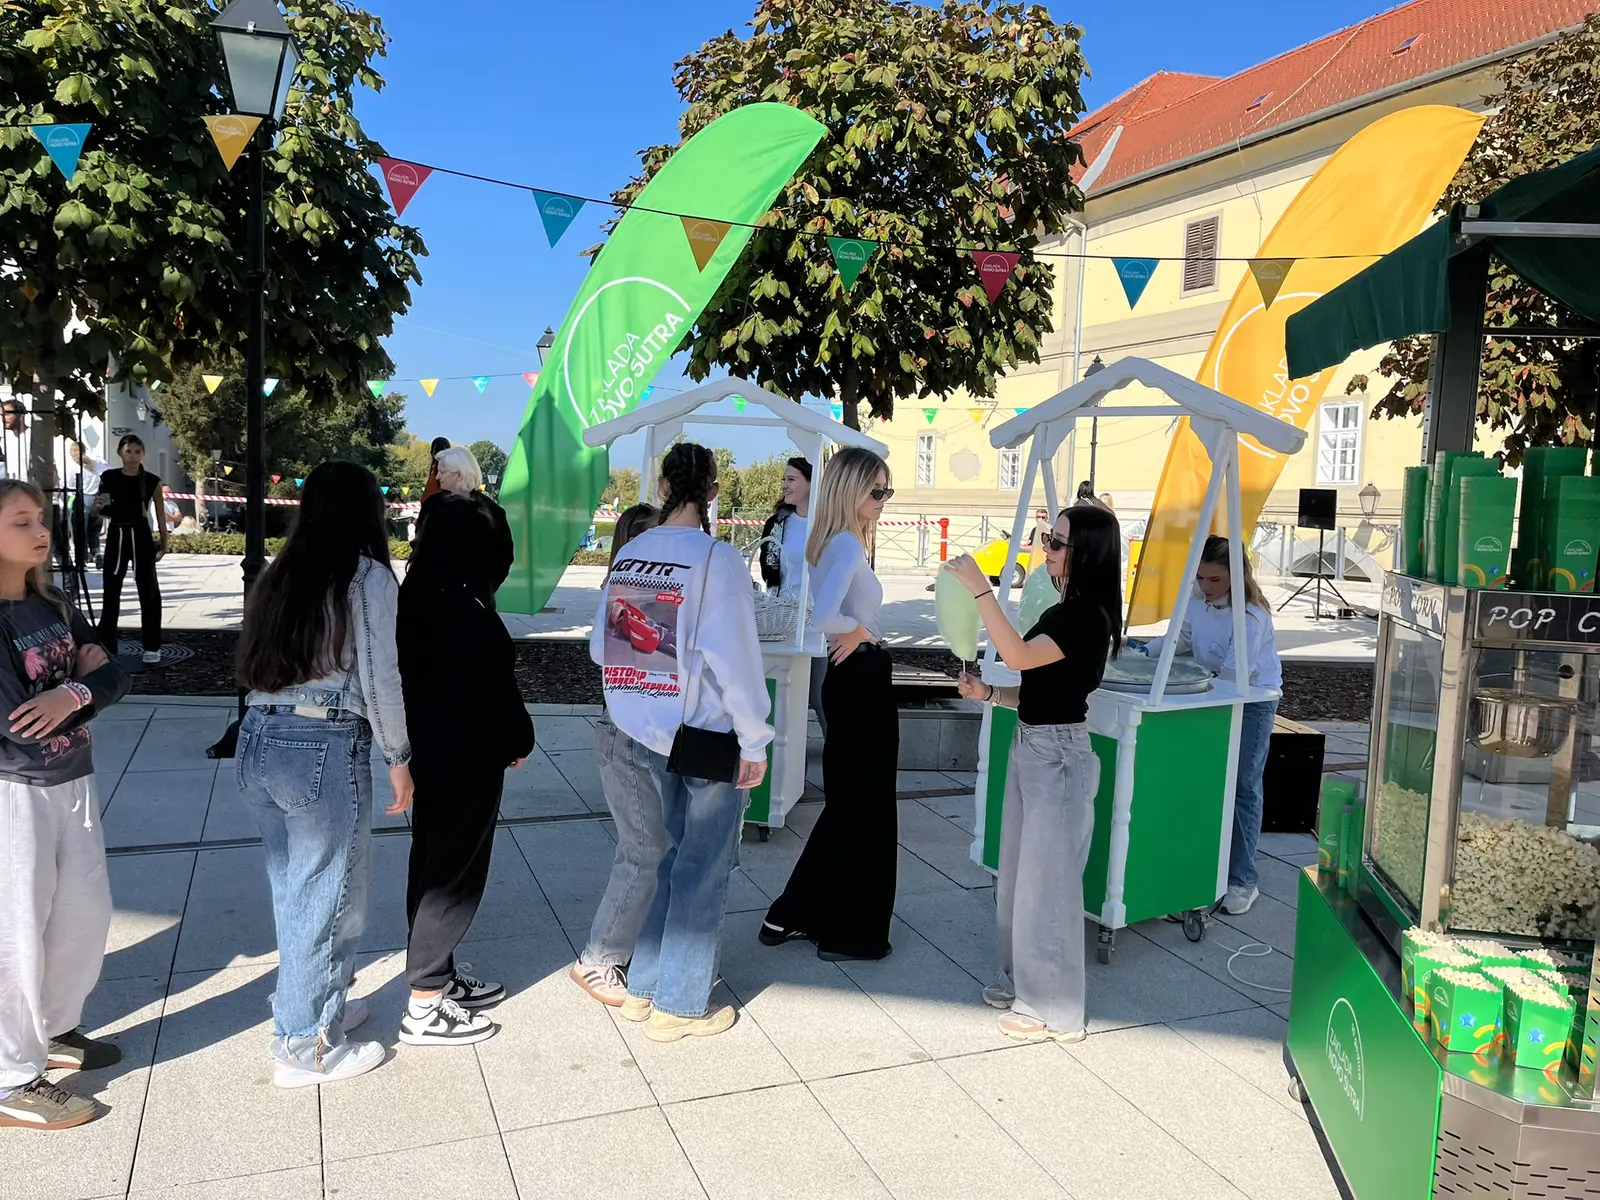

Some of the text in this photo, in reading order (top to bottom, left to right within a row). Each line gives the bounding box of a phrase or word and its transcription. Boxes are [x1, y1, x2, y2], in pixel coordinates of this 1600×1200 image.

[630, 312, 684, 378] SUTRA
[1278, 384, 1310, 425] OVO
[1487, 606, 1556, 630] POP
[1343, 1074, 1360, 1117] SUTRA
